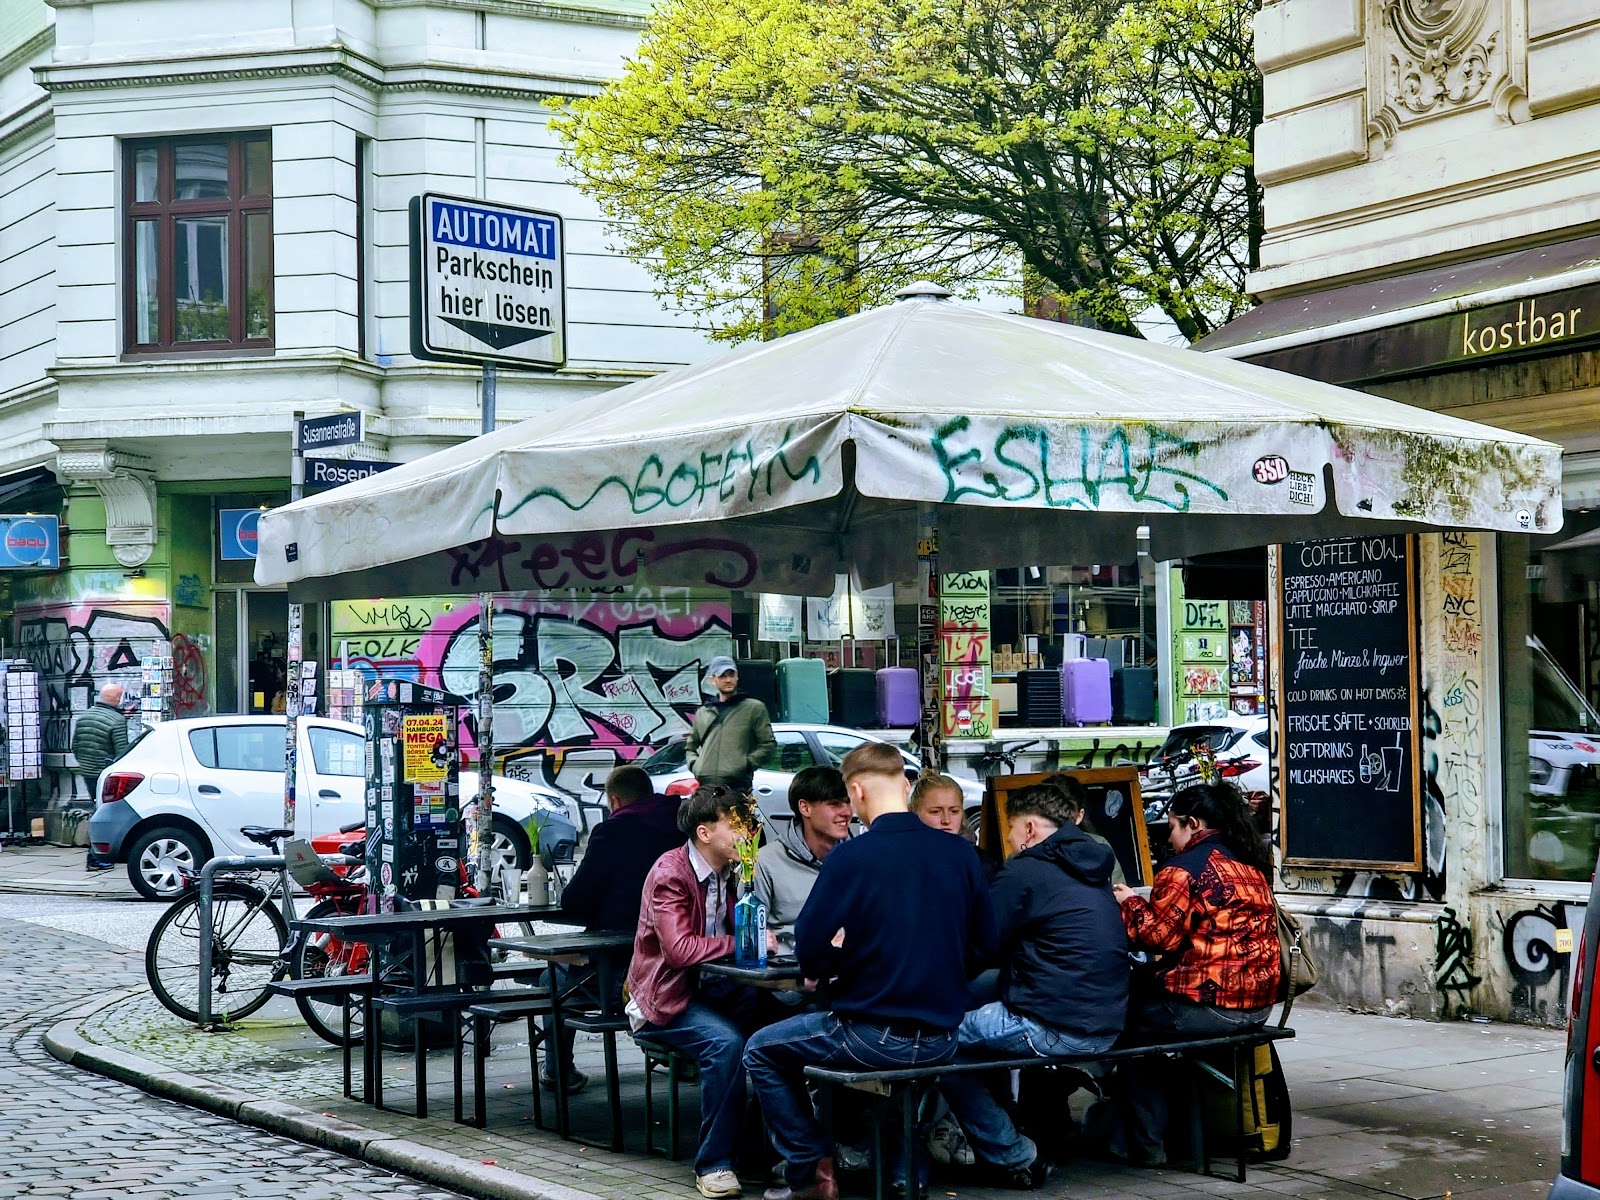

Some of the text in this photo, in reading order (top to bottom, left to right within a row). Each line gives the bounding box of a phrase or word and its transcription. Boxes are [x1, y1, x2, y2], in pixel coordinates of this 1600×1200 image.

[437, 207, 551, 255] AUTOMAT
[437, 246, 552, 289] Parkschein
[441, 286, 550, 327] hier lösen
[1463, 299, 1581, 356] kostbar
[303, 418, 355, 443] Susannenstraße
[1289, 472, 1314, 484] HECK
[1289, 481, 1314, 493] LIEBT
[1289, 491, 1313, 504] DICH!
[1300, 542, 1358, 567] COFFEE
[1284, 568, 1383, 590] ESPRESSO AMERICANO
[1285, 582, 1400, 604] CAPPUCCINO MILCHKAFFEE
[1285, 600, 1398, 619] LATTE MACCHIATO SIRUP
[1288, 628, 1319, 649] TEE
[1294, 651, 1328, 679] frische
[1331, 649, 1362, 668] Minze
[1372, 648, 1408, 675] Ingwer
[1287, 688, 1396, 702] COLD DRINKS ON HOT DAYS
[1288, 712, 1411, 732] FRISCHE SÄFTE SCHORLEN
[407, 732, 444, 743] MEGA
[1289, 743, 1354, 760] SOFTDRINKS
[1289, 769, 1355, 784] MILCHSHAKES
